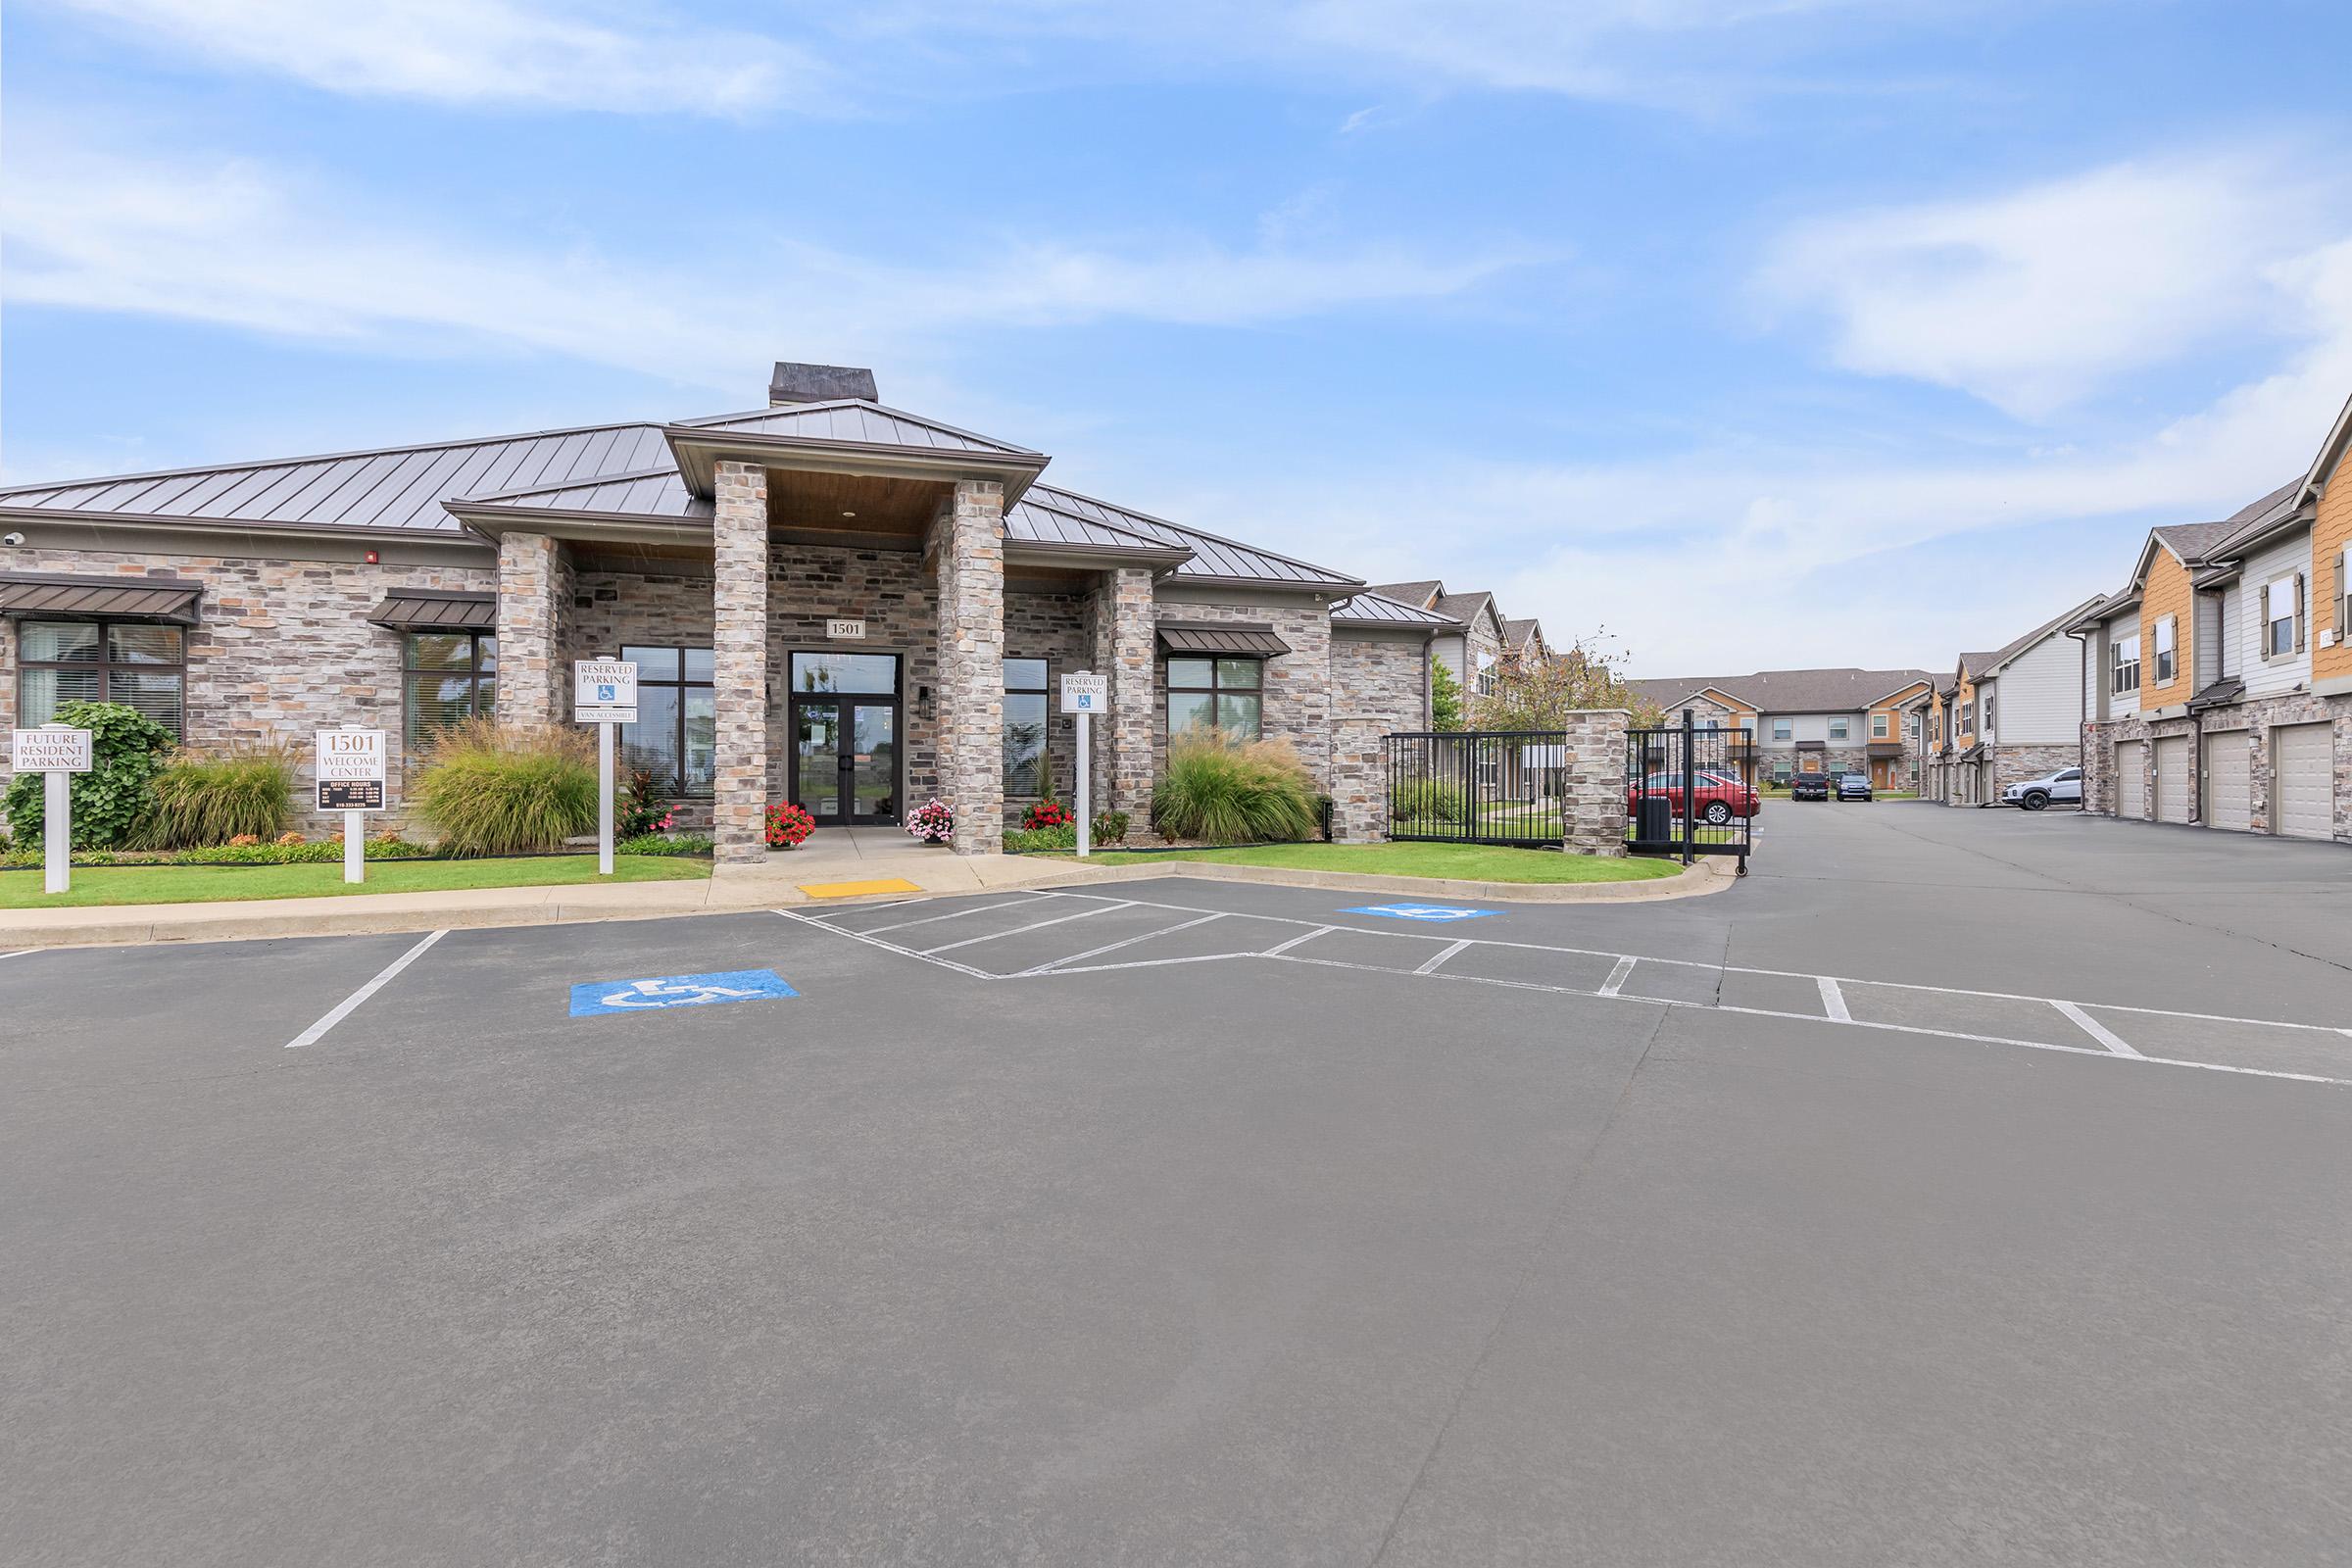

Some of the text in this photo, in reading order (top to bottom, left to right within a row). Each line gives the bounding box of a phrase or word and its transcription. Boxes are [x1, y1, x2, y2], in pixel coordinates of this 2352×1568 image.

[832, 623, 859, 635] 1501
[580, 664, 633, 674] RESERVED
[583, 675, 630, 684] PARKING
[1065, 677, 1104, 686] RESERVED
[1067, 686, 1102, 695] PARKING
[26, 734, 78, 744] FUTURE
[328, 735, 373, 751] 1501
[21, 746, 84, 756] RESIDENT
[23, 757, 82, 767] PARKING
[323, 757, 379, 766] WELCOME
[330, 767, 371, 776] CENTER
